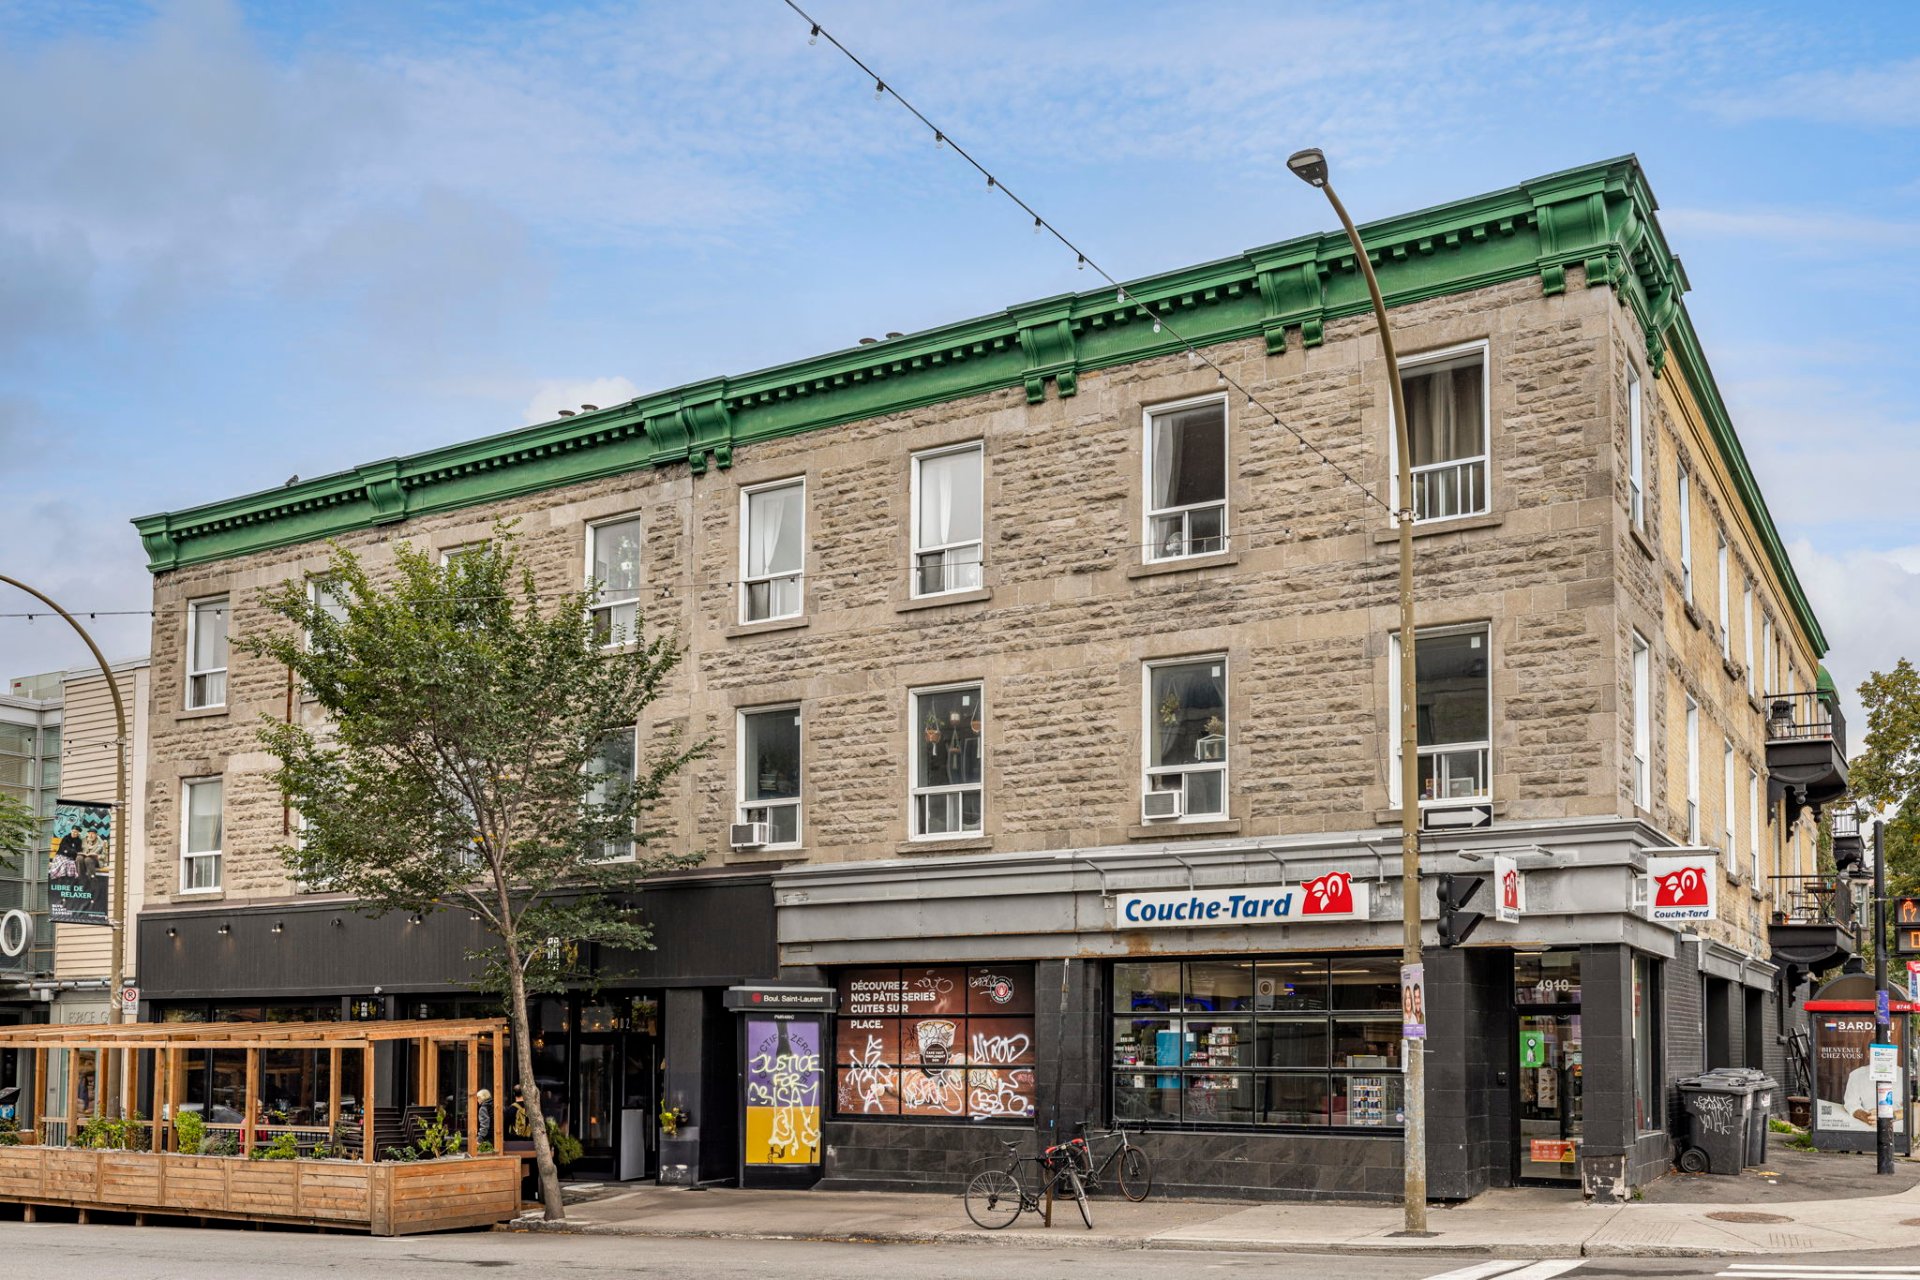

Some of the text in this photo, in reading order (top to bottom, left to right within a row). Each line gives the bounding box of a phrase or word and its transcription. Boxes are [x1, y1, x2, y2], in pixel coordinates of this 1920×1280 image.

[61, 891, 92, 899] RELAXER
[1125, 893, 1293, 922] Couche-Tard
[1654, 909, 1709, 918] Couche-Tard
[850, 979, 909, 991] DÉCOUVREZ
[1536, 979, 1570, 992] 4910
[763, 994, 824, 1003] Boul. Saint-Laurent
[850, 990, 936, 1002] NOS PÂTISSERIES
[850, 1004, 909, 1013] CUITES SUR
[850, 1019, 884, 1029] PLACE.
[1838, 1021, 1895, 1031] BARDI
[749, 1053, 825, 1073] JUSTICE
[773, 1072, 808, 1089] FOR
